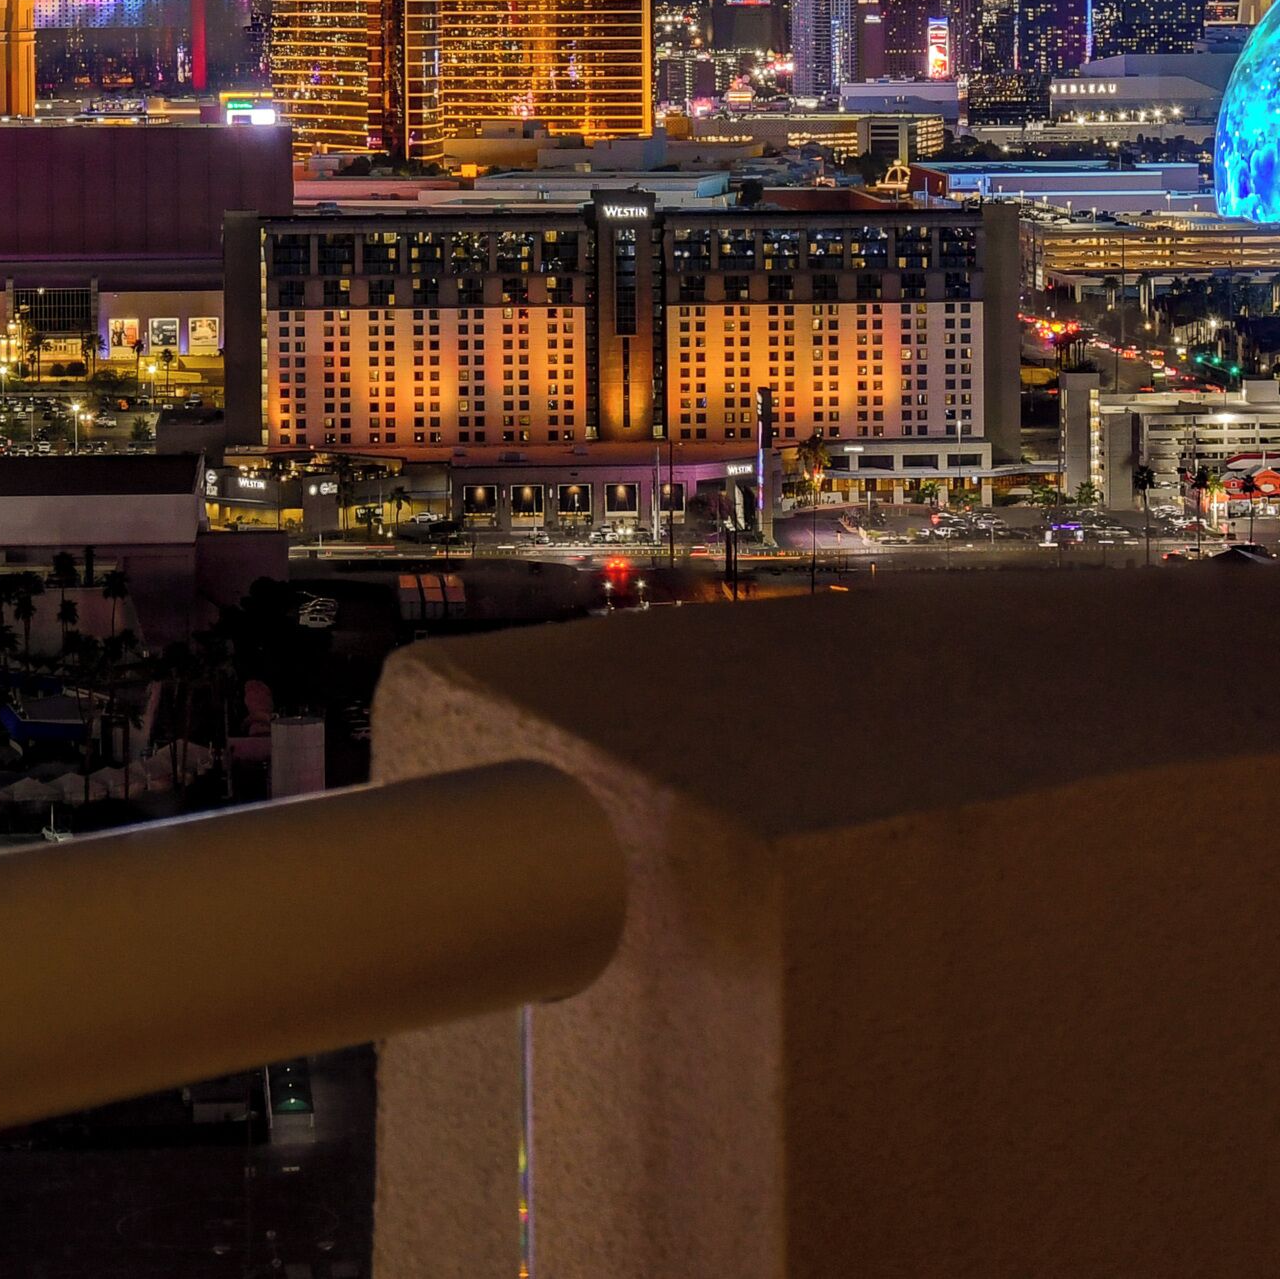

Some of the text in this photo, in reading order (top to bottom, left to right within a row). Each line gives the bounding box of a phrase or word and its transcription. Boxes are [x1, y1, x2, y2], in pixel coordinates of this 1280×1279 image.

[603, 204, 648, 218] WESTIN
[727, 464, 753, 476] WESTIN
[238, 477, 267, 490] WESTIN
